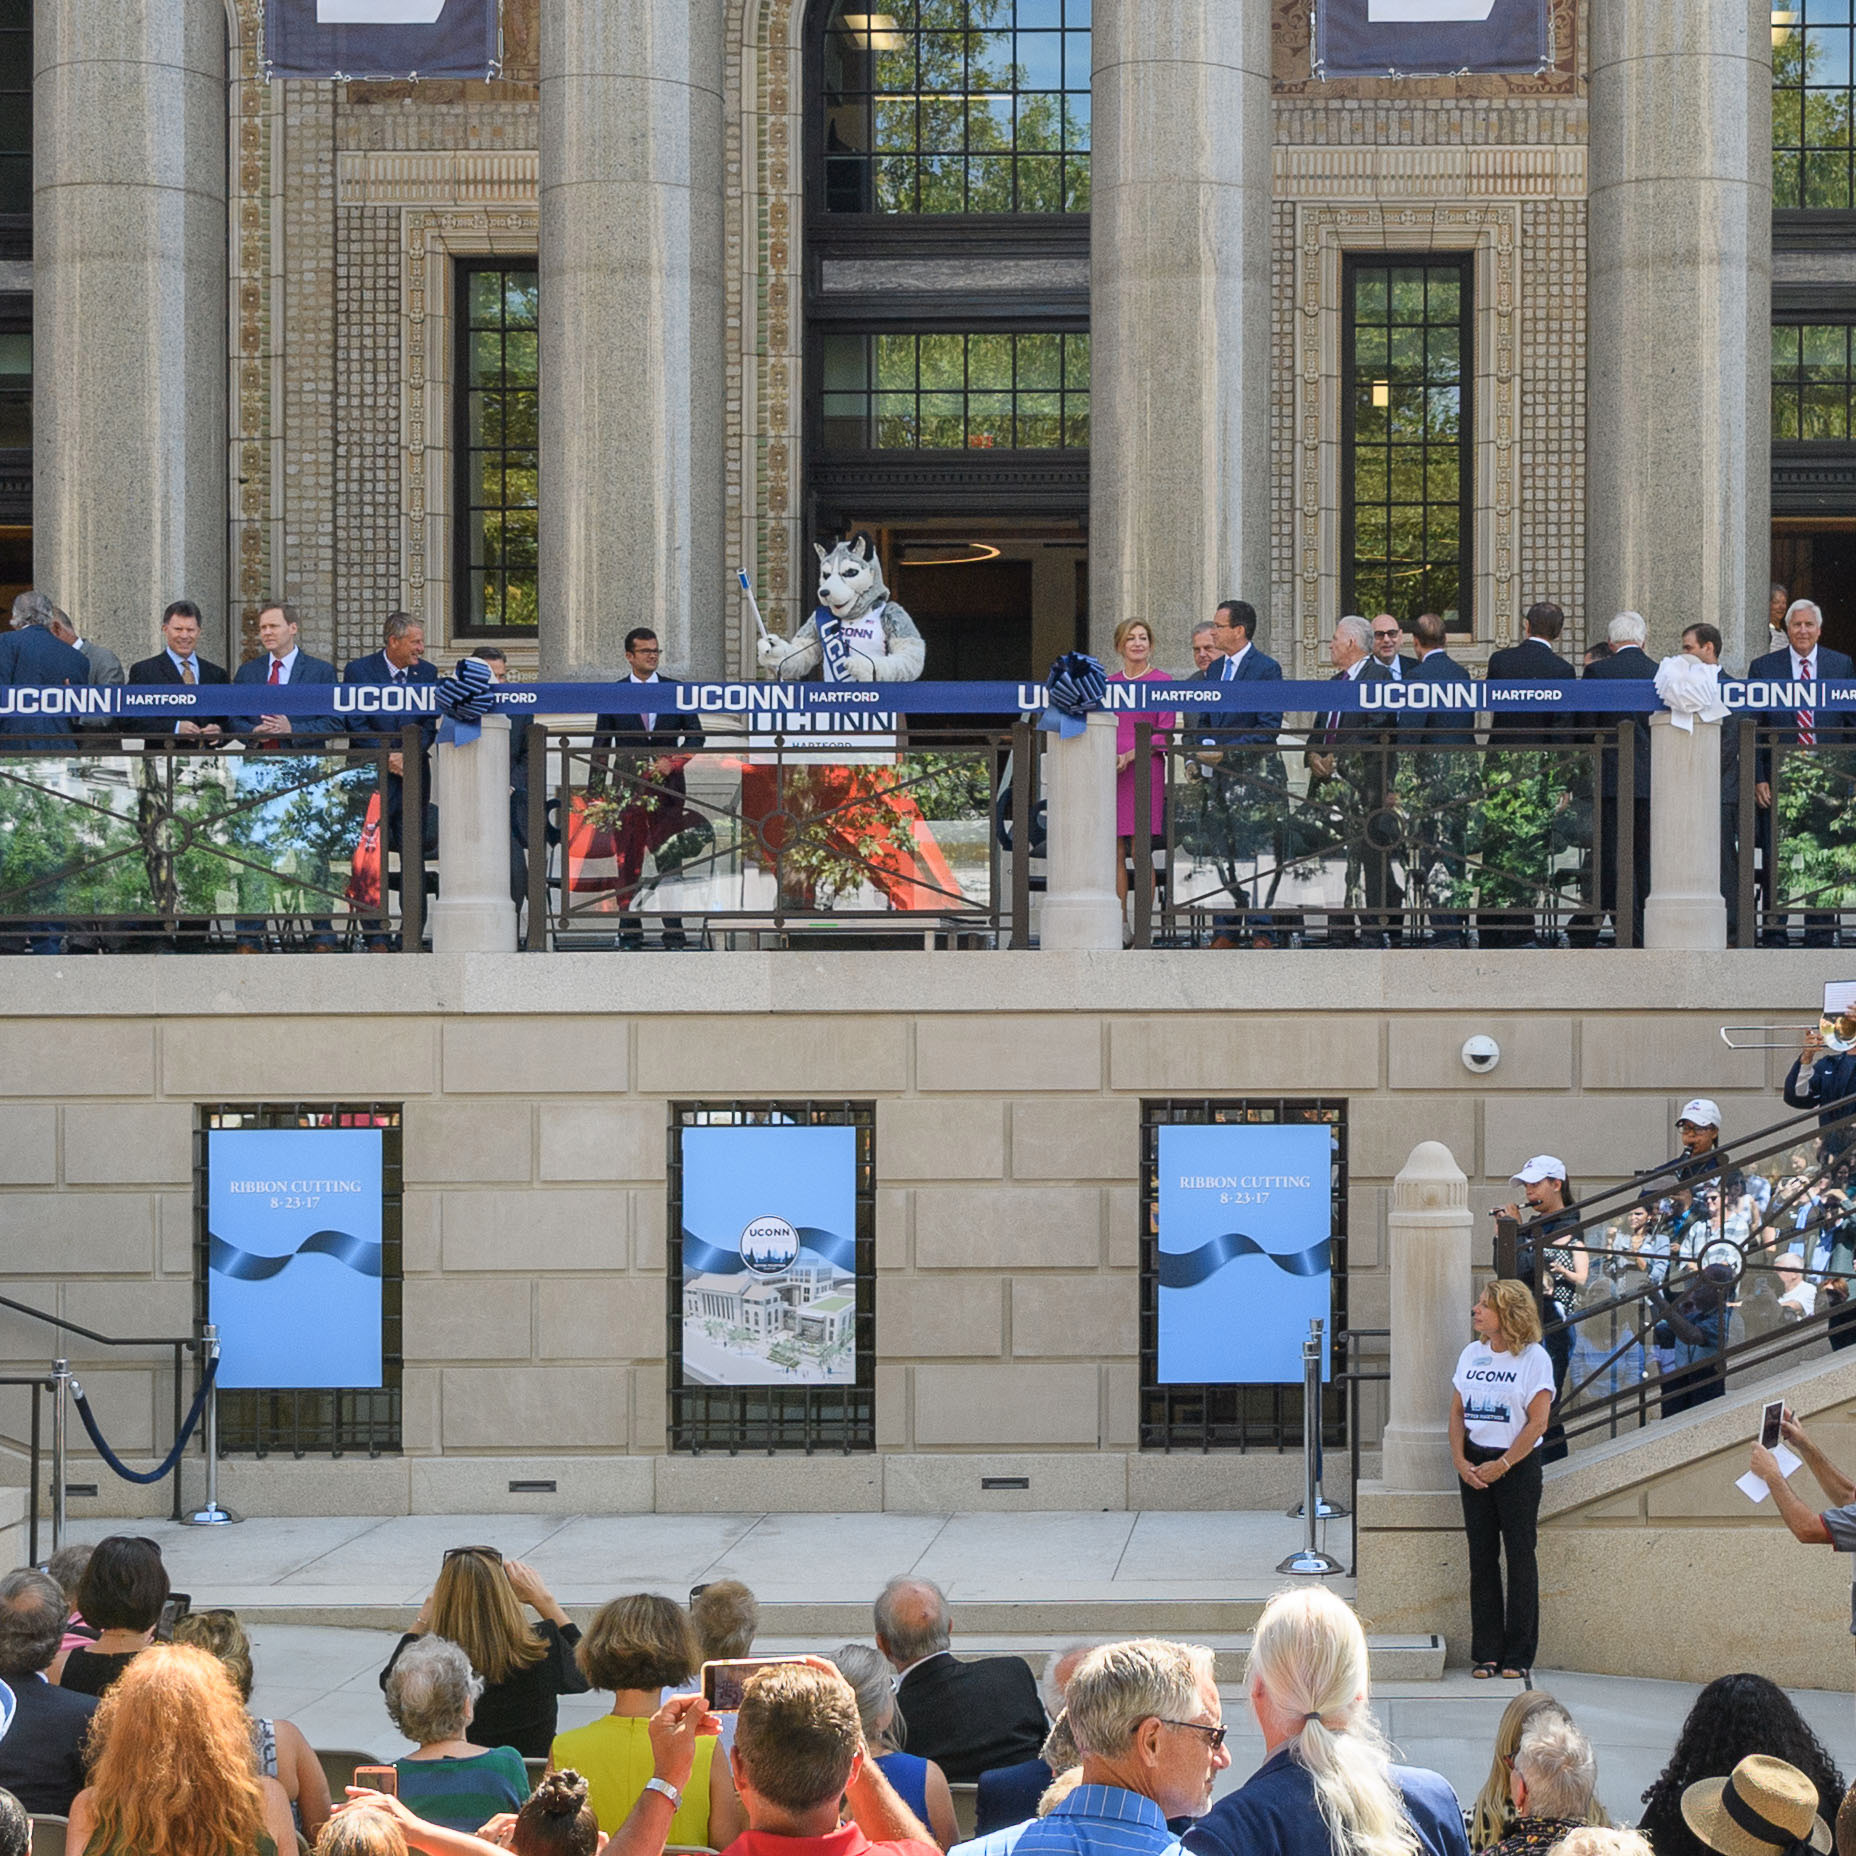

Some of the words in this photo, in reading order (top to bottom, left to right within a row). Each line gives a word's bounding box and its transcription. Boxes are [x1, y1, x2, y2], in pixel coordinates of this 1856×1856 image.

[125, 694, 197, 706] HARTFORD
[333, 686, 436, 712] UCON
[492, 692, 538, 704] TFORD
[676, 684, 795, 711] UCONN
[808, 690, 880, 703] HARTFORD
[1150, 690, 1222, 702] HARTFORD
[1359, 682, 1477, 709] UCONN
[1491, 689, 1562, 701] HARTFORD
[1718, 681, 1817, 708] CONN
[230, 1179, 288, 1194] RIBBON
[291, 1179, 362, 1194] CUTTING
[1179, 1175, 1238, 1189] RIBBON
[1240, 1175, 1311, 1189] CUTTING
[749, 1228, 790, 1237] UCONN
[1466, 1369, 1517, 1383] UCONN
